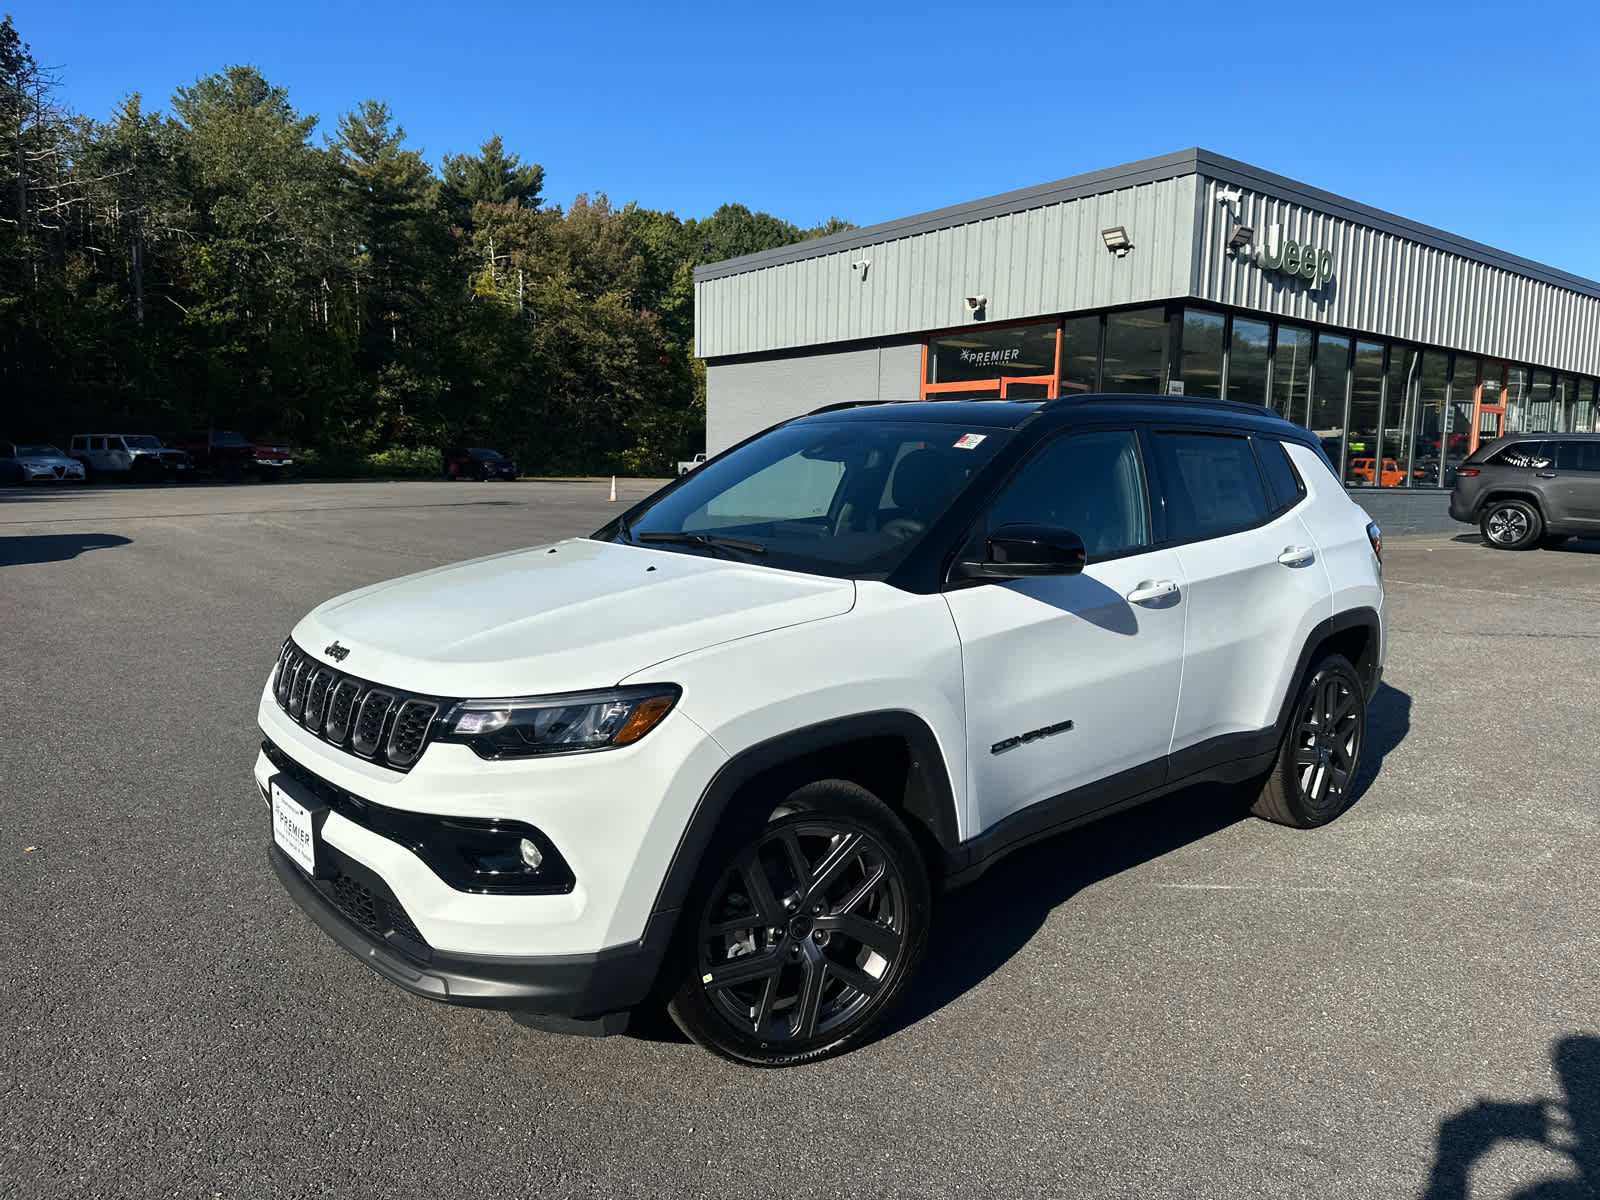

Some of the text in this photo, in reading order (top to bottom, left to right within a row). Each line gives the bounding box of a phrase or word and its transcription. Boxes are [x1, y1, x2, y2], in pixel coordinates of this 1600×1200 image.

[1265, 223, 1333, 290] Jeep
[969, 349, 1019, 363] PREMIER
[279, 813, 310, 846] PREMIER
